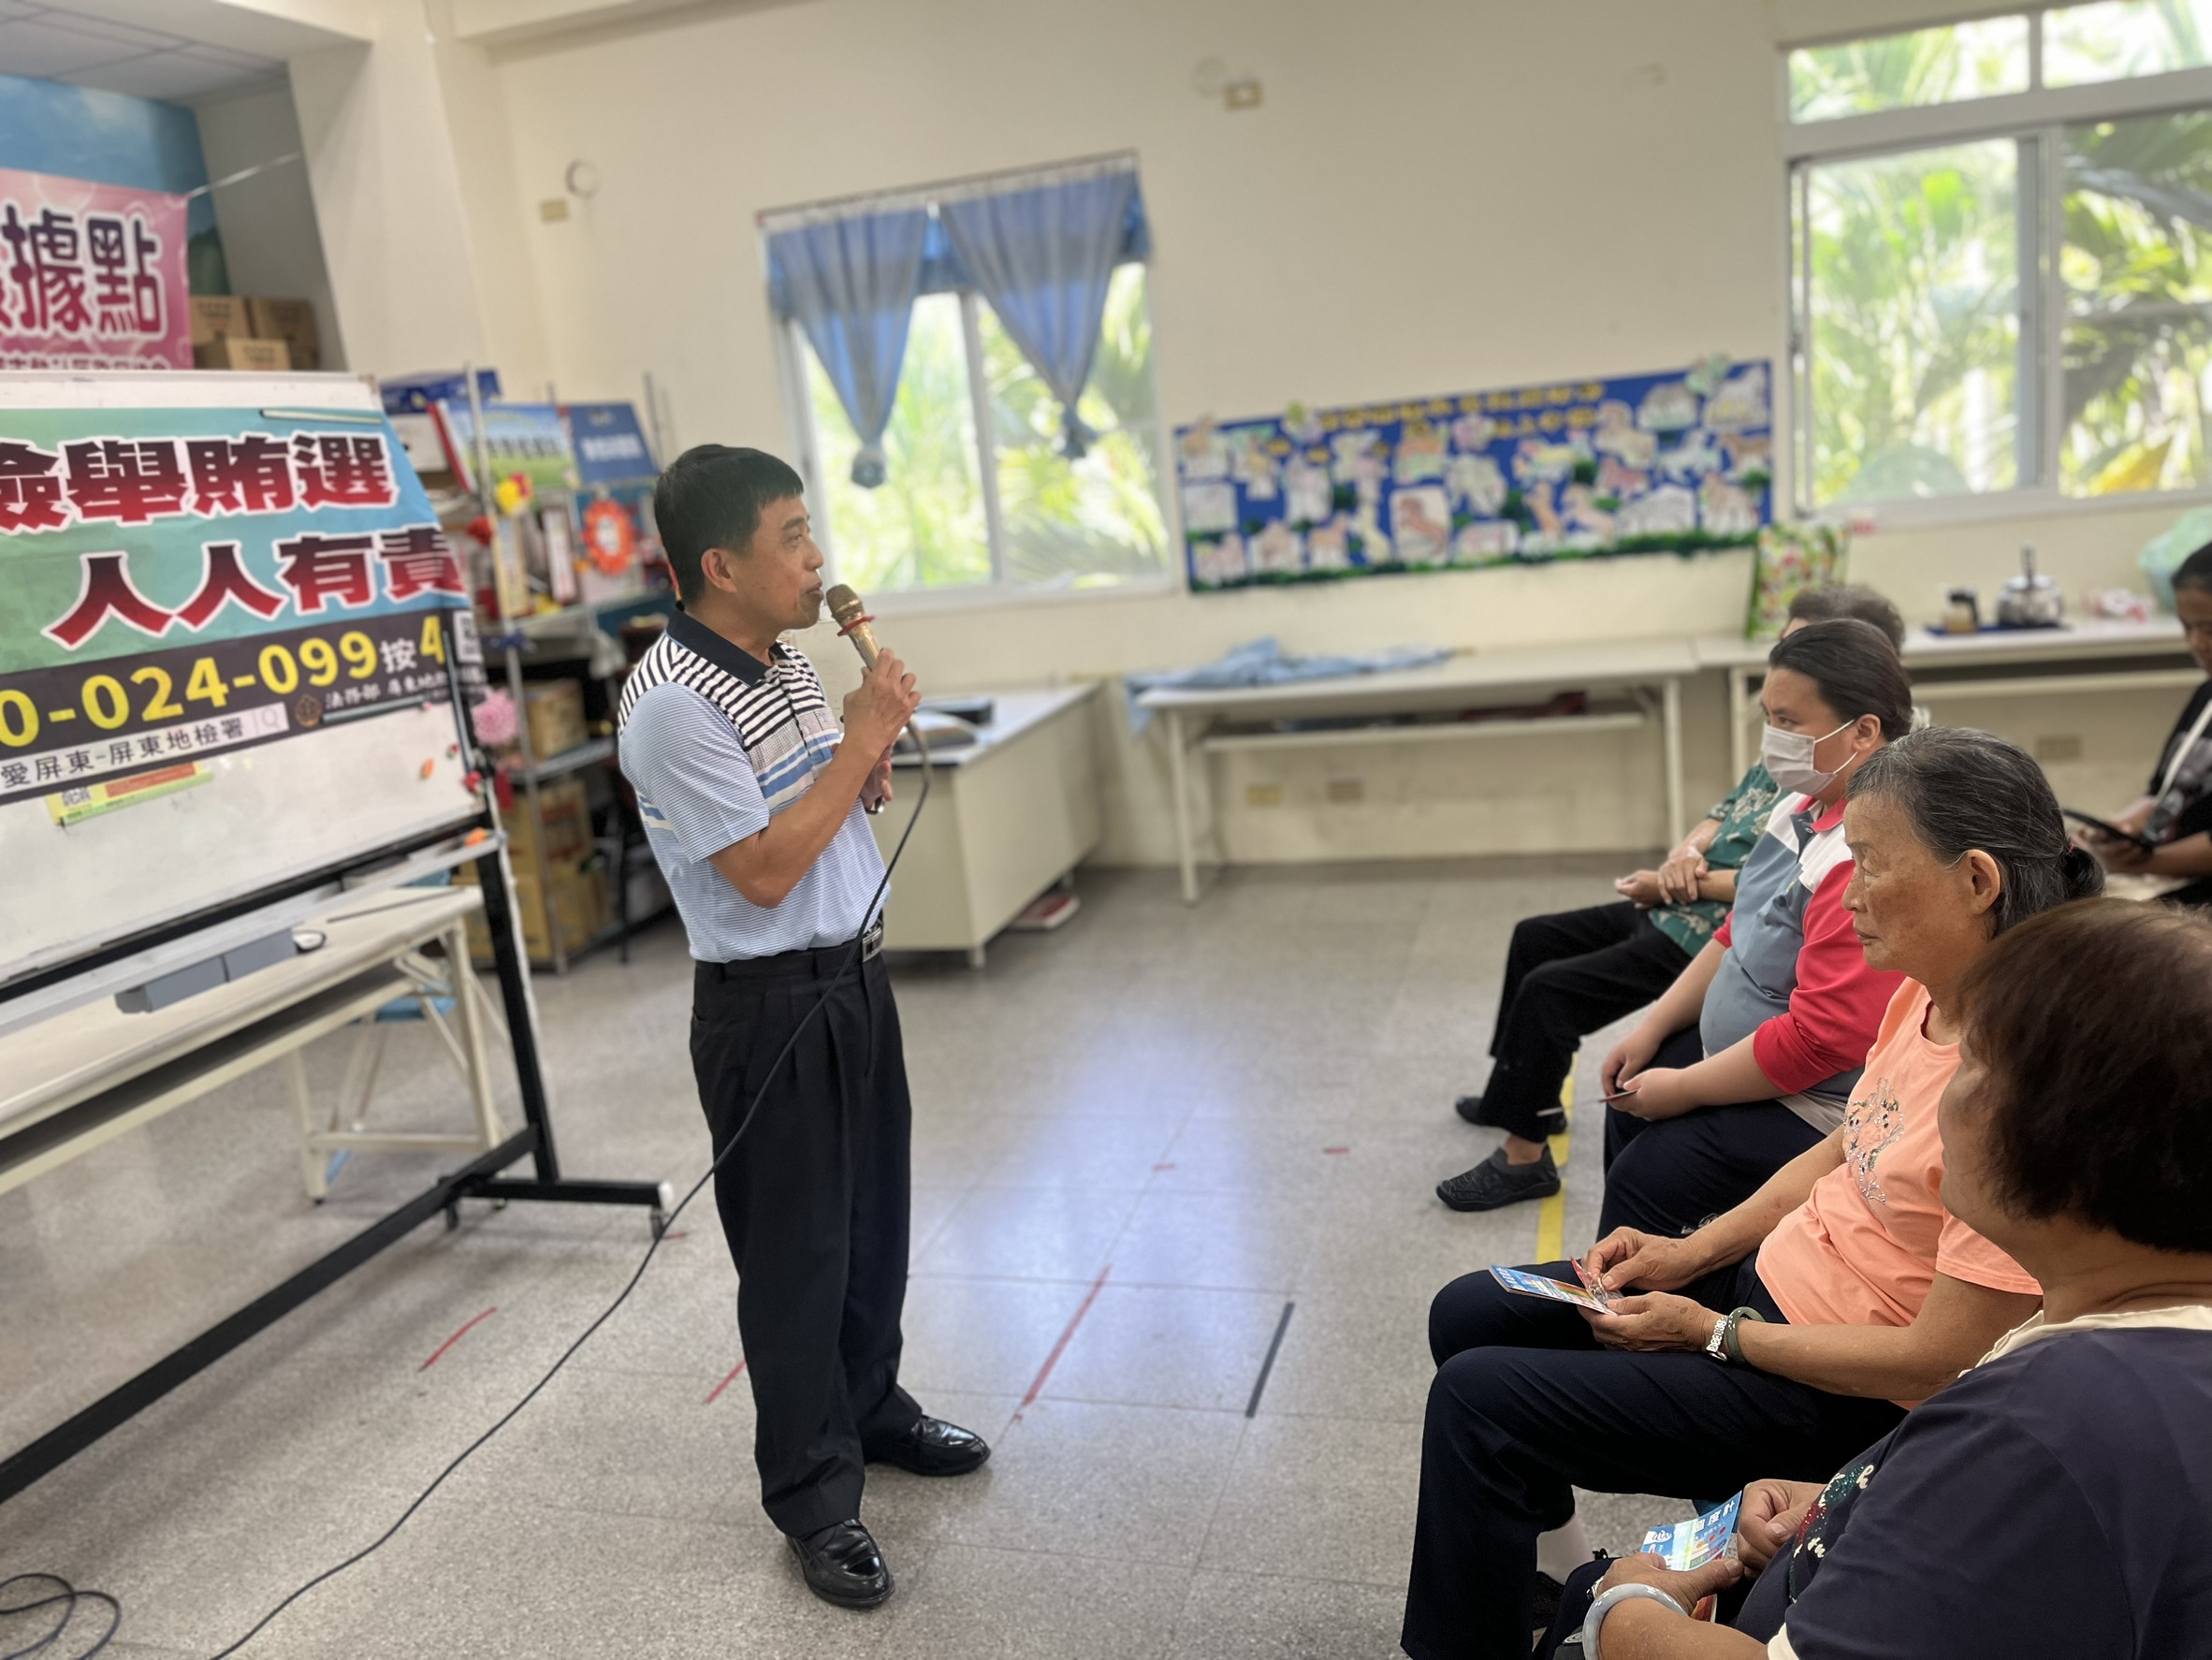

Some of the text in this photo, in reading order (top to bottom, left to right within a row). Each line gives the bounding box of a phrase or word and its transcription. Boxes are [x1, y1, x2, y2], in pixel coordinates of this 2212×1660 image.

[0, 203, 163, 333] 據點
[45, 528, 466, 648] 人人有責
[325, 683, 382, 709] 法務部
[0, 716, 244, 788] 愛屏東-屏東地檢署
